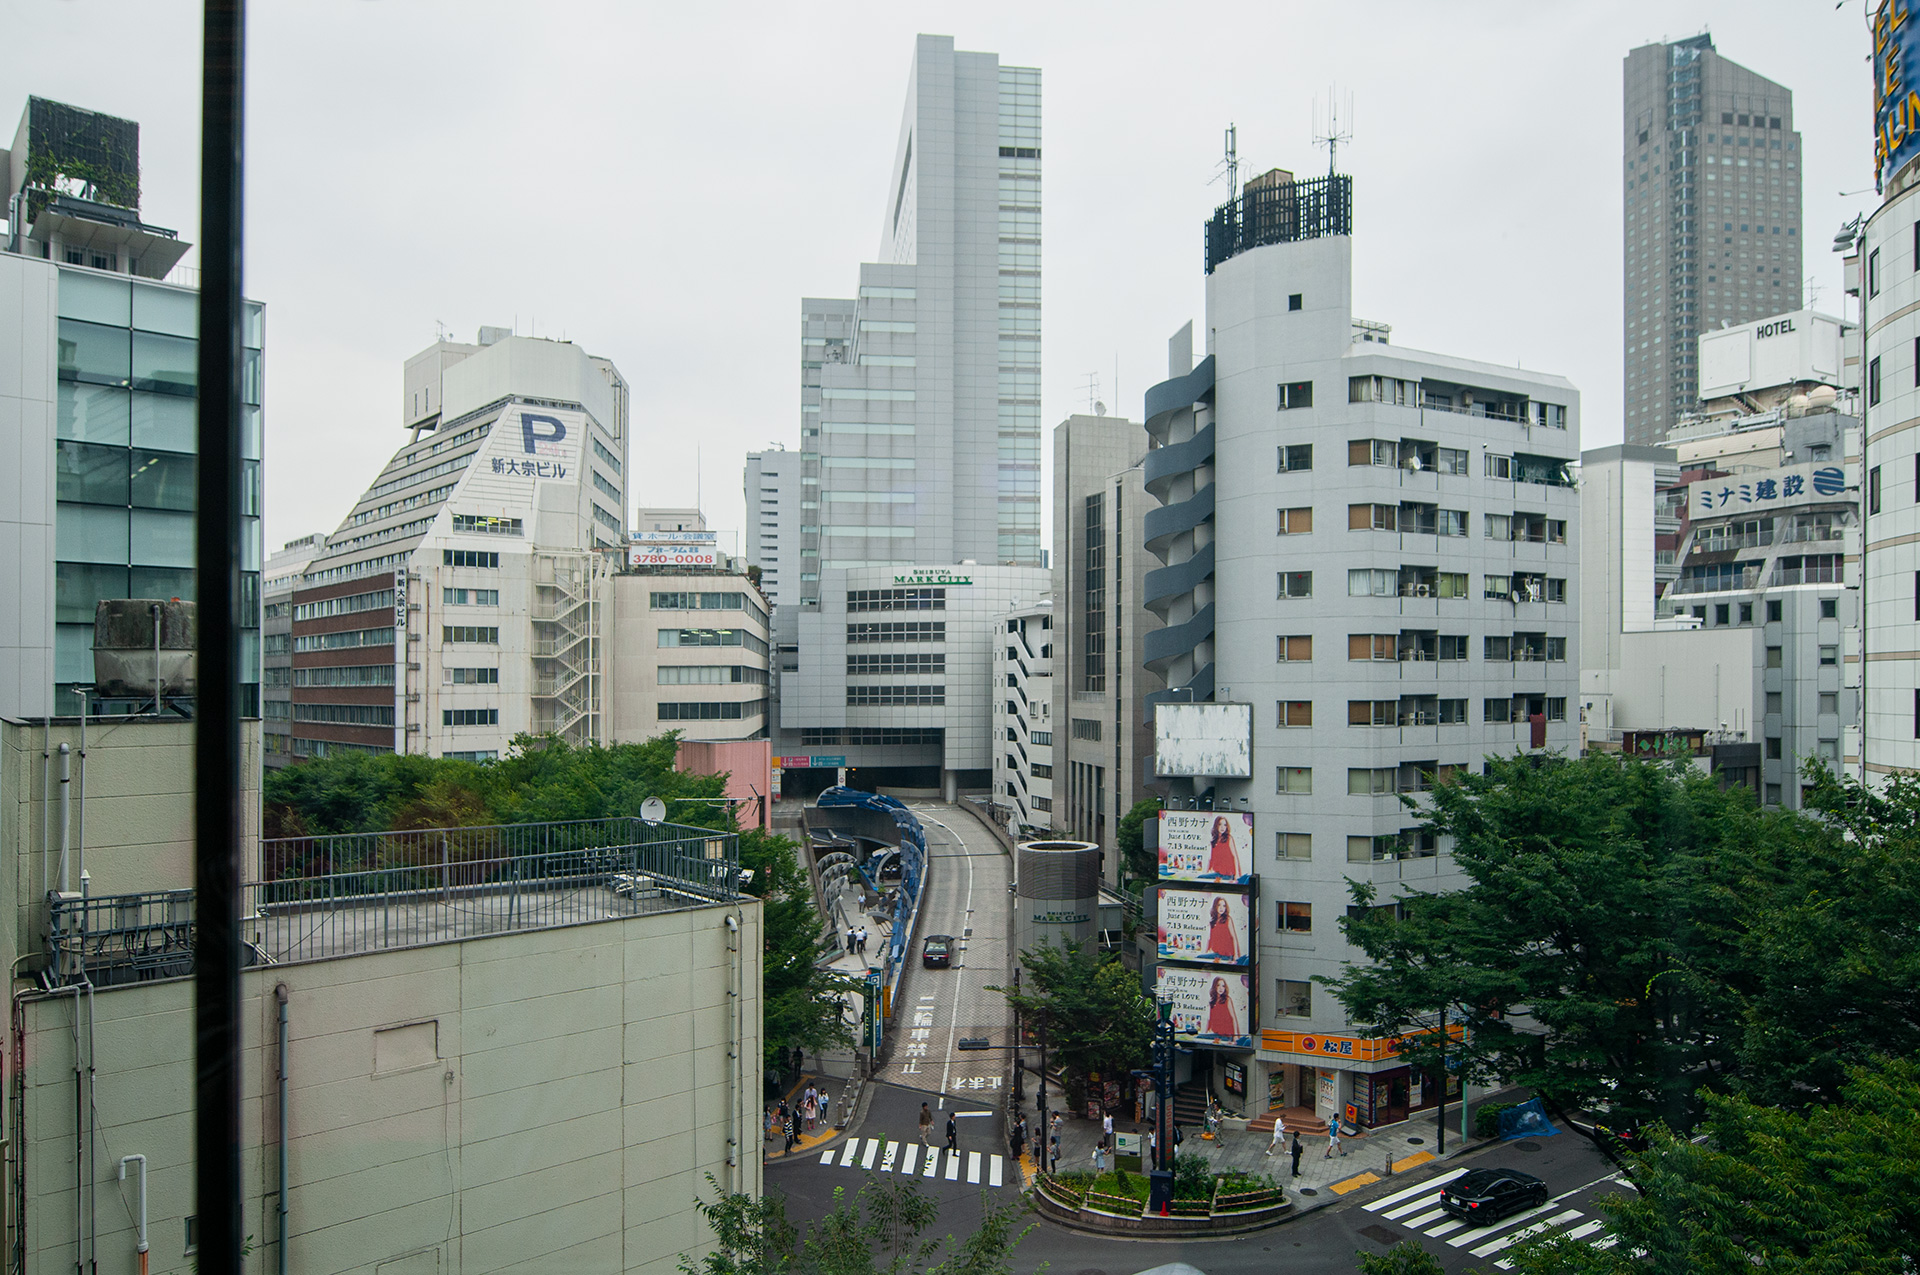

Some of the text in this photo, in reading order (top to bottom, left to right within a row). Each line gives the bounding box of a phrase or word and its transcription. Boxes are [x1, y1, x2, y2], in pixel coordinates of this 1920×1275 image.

[1756, 319, 1796, 339] HOTEL
[520, 412, 567, 454] P
[491, 457, 566, 479] 新大宗ビル
[1700, 474, 1805, 510] ミナミ建設
[633, 554, 713, 564] 3780-0008
[893, 575, 971, 584] MARK CITY
[1167, 816, 1209, 828] 西野カナ
[1167, 842, 1183, 850] 7.13
[1166, 896, 1208, 908] 西野カナ
[1166, 922, 1182, 930] 7.13
[1166, 976, 1208, 988] 西野カナ
[901, 996, 935, 1074] 二輪車禁止
[1322, 1039, 1353, 1055] 松屋
[952, 1077, 1002, 1090] 止まれ
